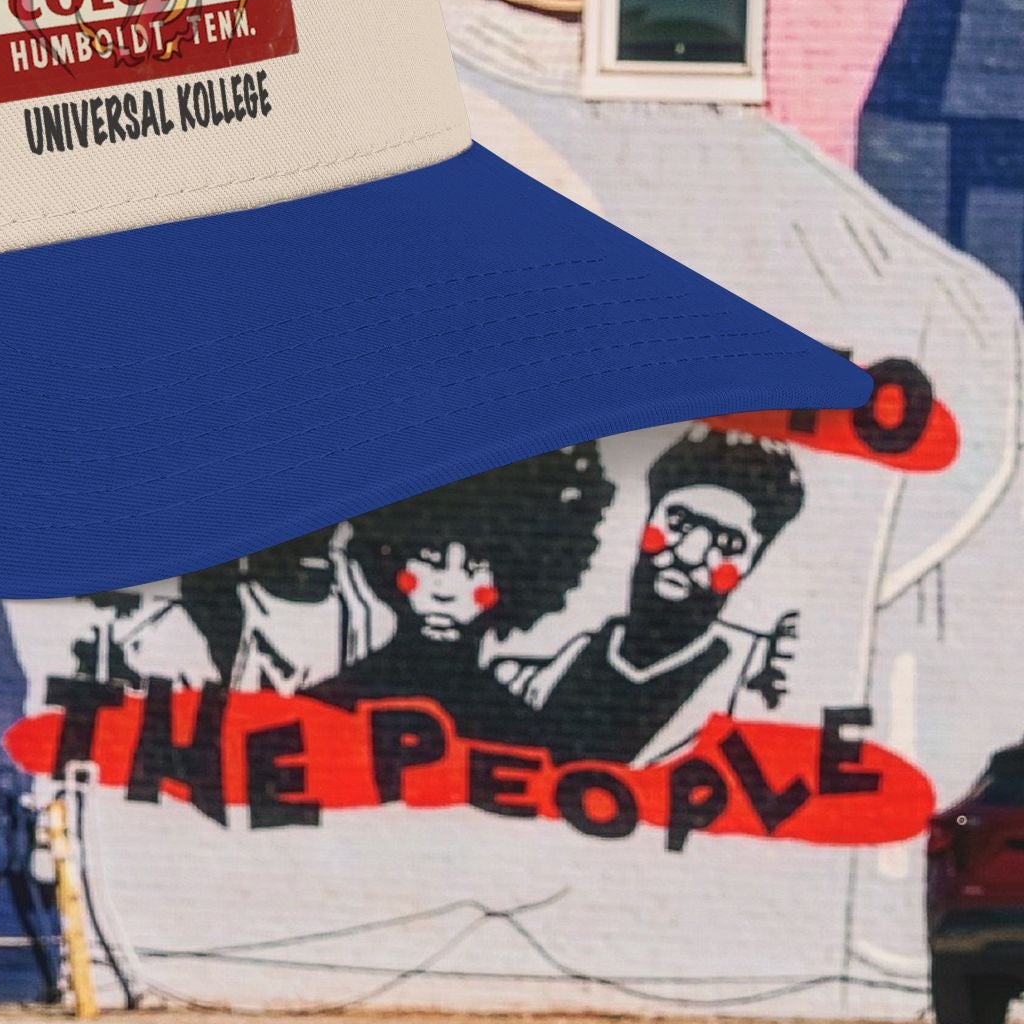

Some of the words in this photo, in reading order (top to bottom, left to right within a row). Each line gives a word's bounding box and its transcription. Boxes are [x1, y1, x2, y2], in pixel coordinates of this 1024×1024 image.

[186, 8, 257, 46] TENN.
[23, 88, 174, 155] UNIVERSAL
[177, 69, 272, 132] KOLLEGE
[45, 675, 321, 828] THE
[368, 706, 881, 852] PEOPLE
